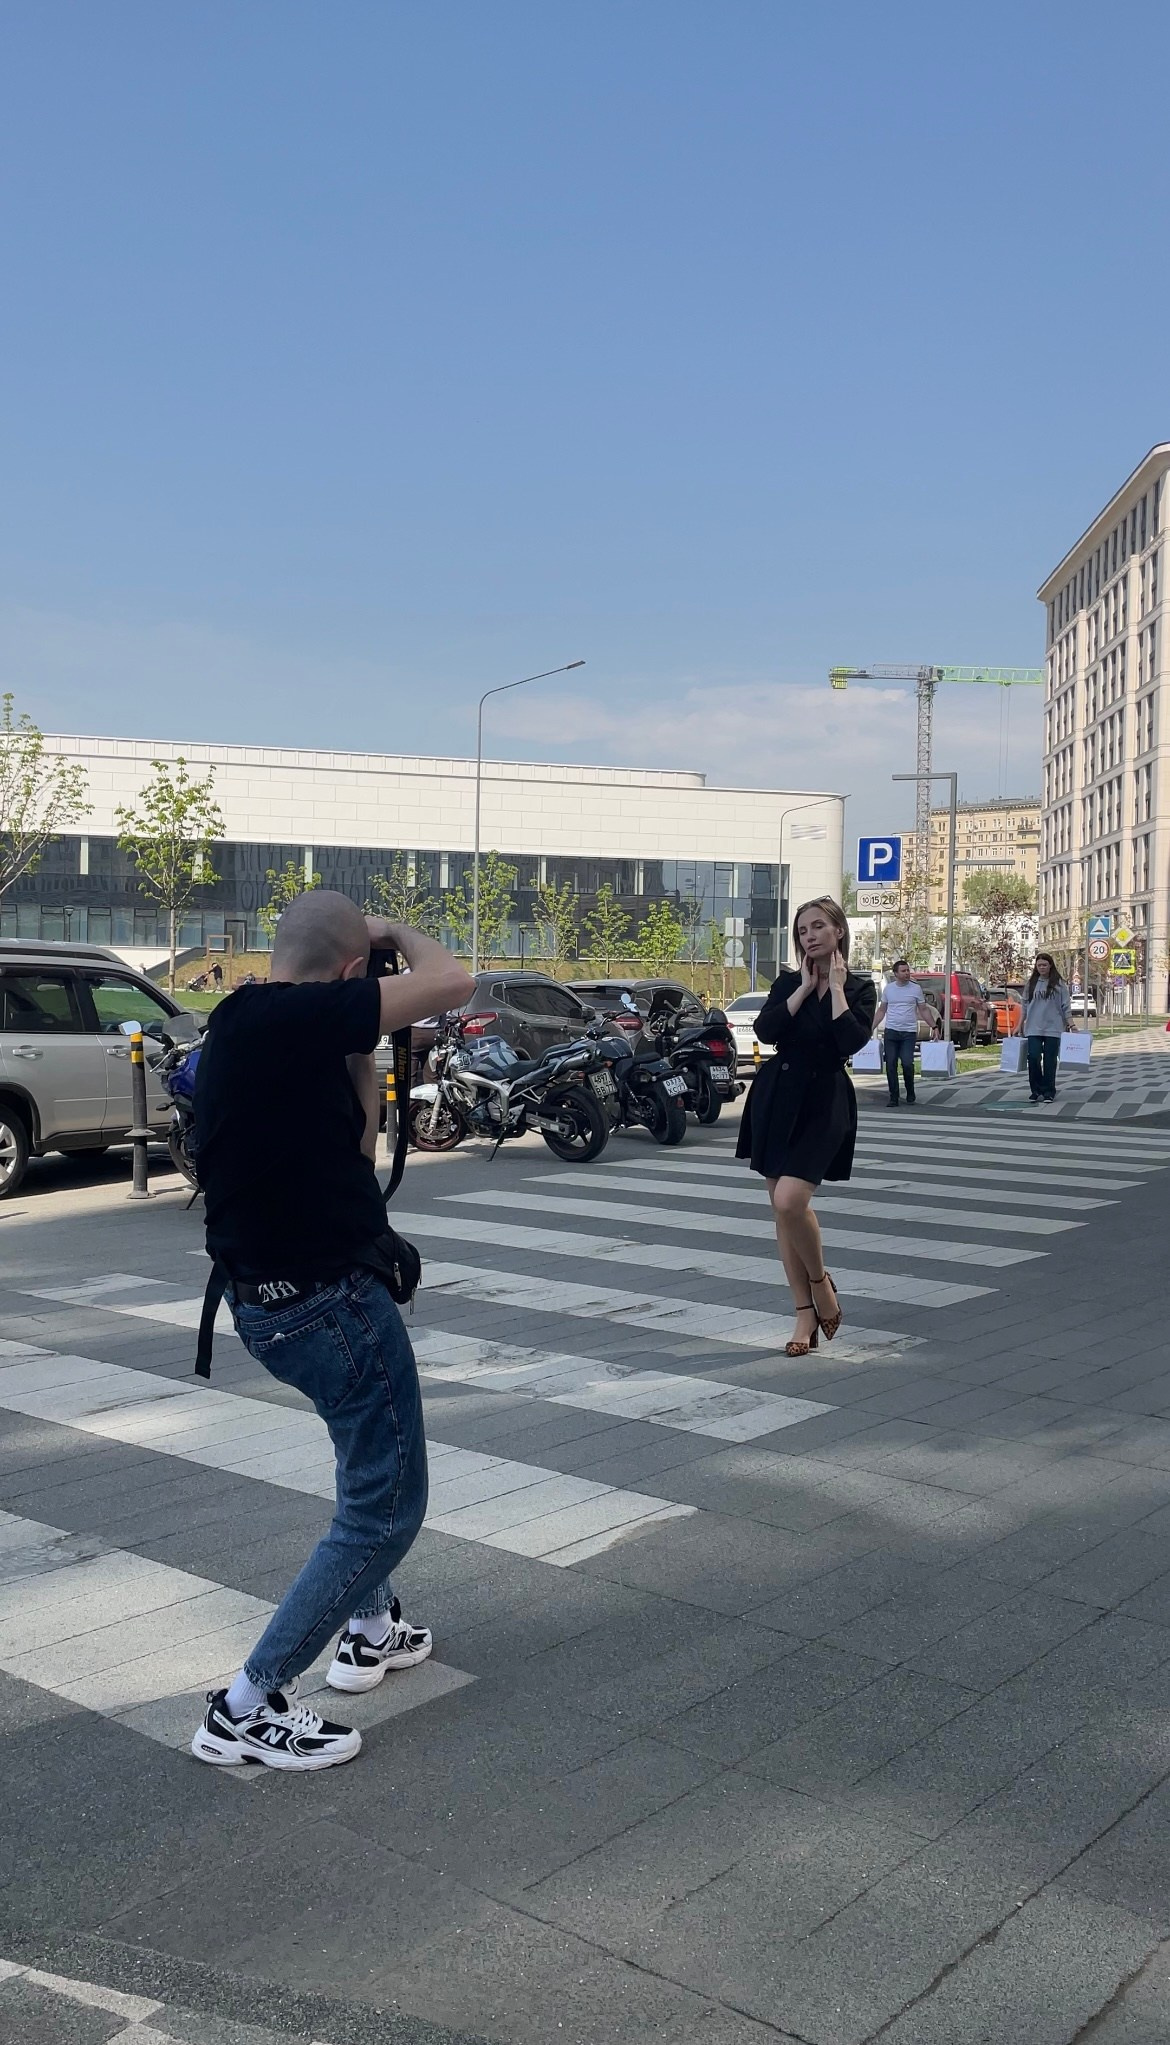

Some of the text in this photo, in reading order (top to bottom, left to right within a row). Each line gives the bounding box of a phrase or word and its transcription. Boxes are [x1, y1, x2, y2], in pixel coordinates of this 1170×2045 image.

[868, 842, 893, 877] P
[882, 895, 895, 905] 20
[1093, 945, 1105, 955] 20
[397, 1045, 407, 1080] Nikon
[260, 1726, 286, 1745] N
